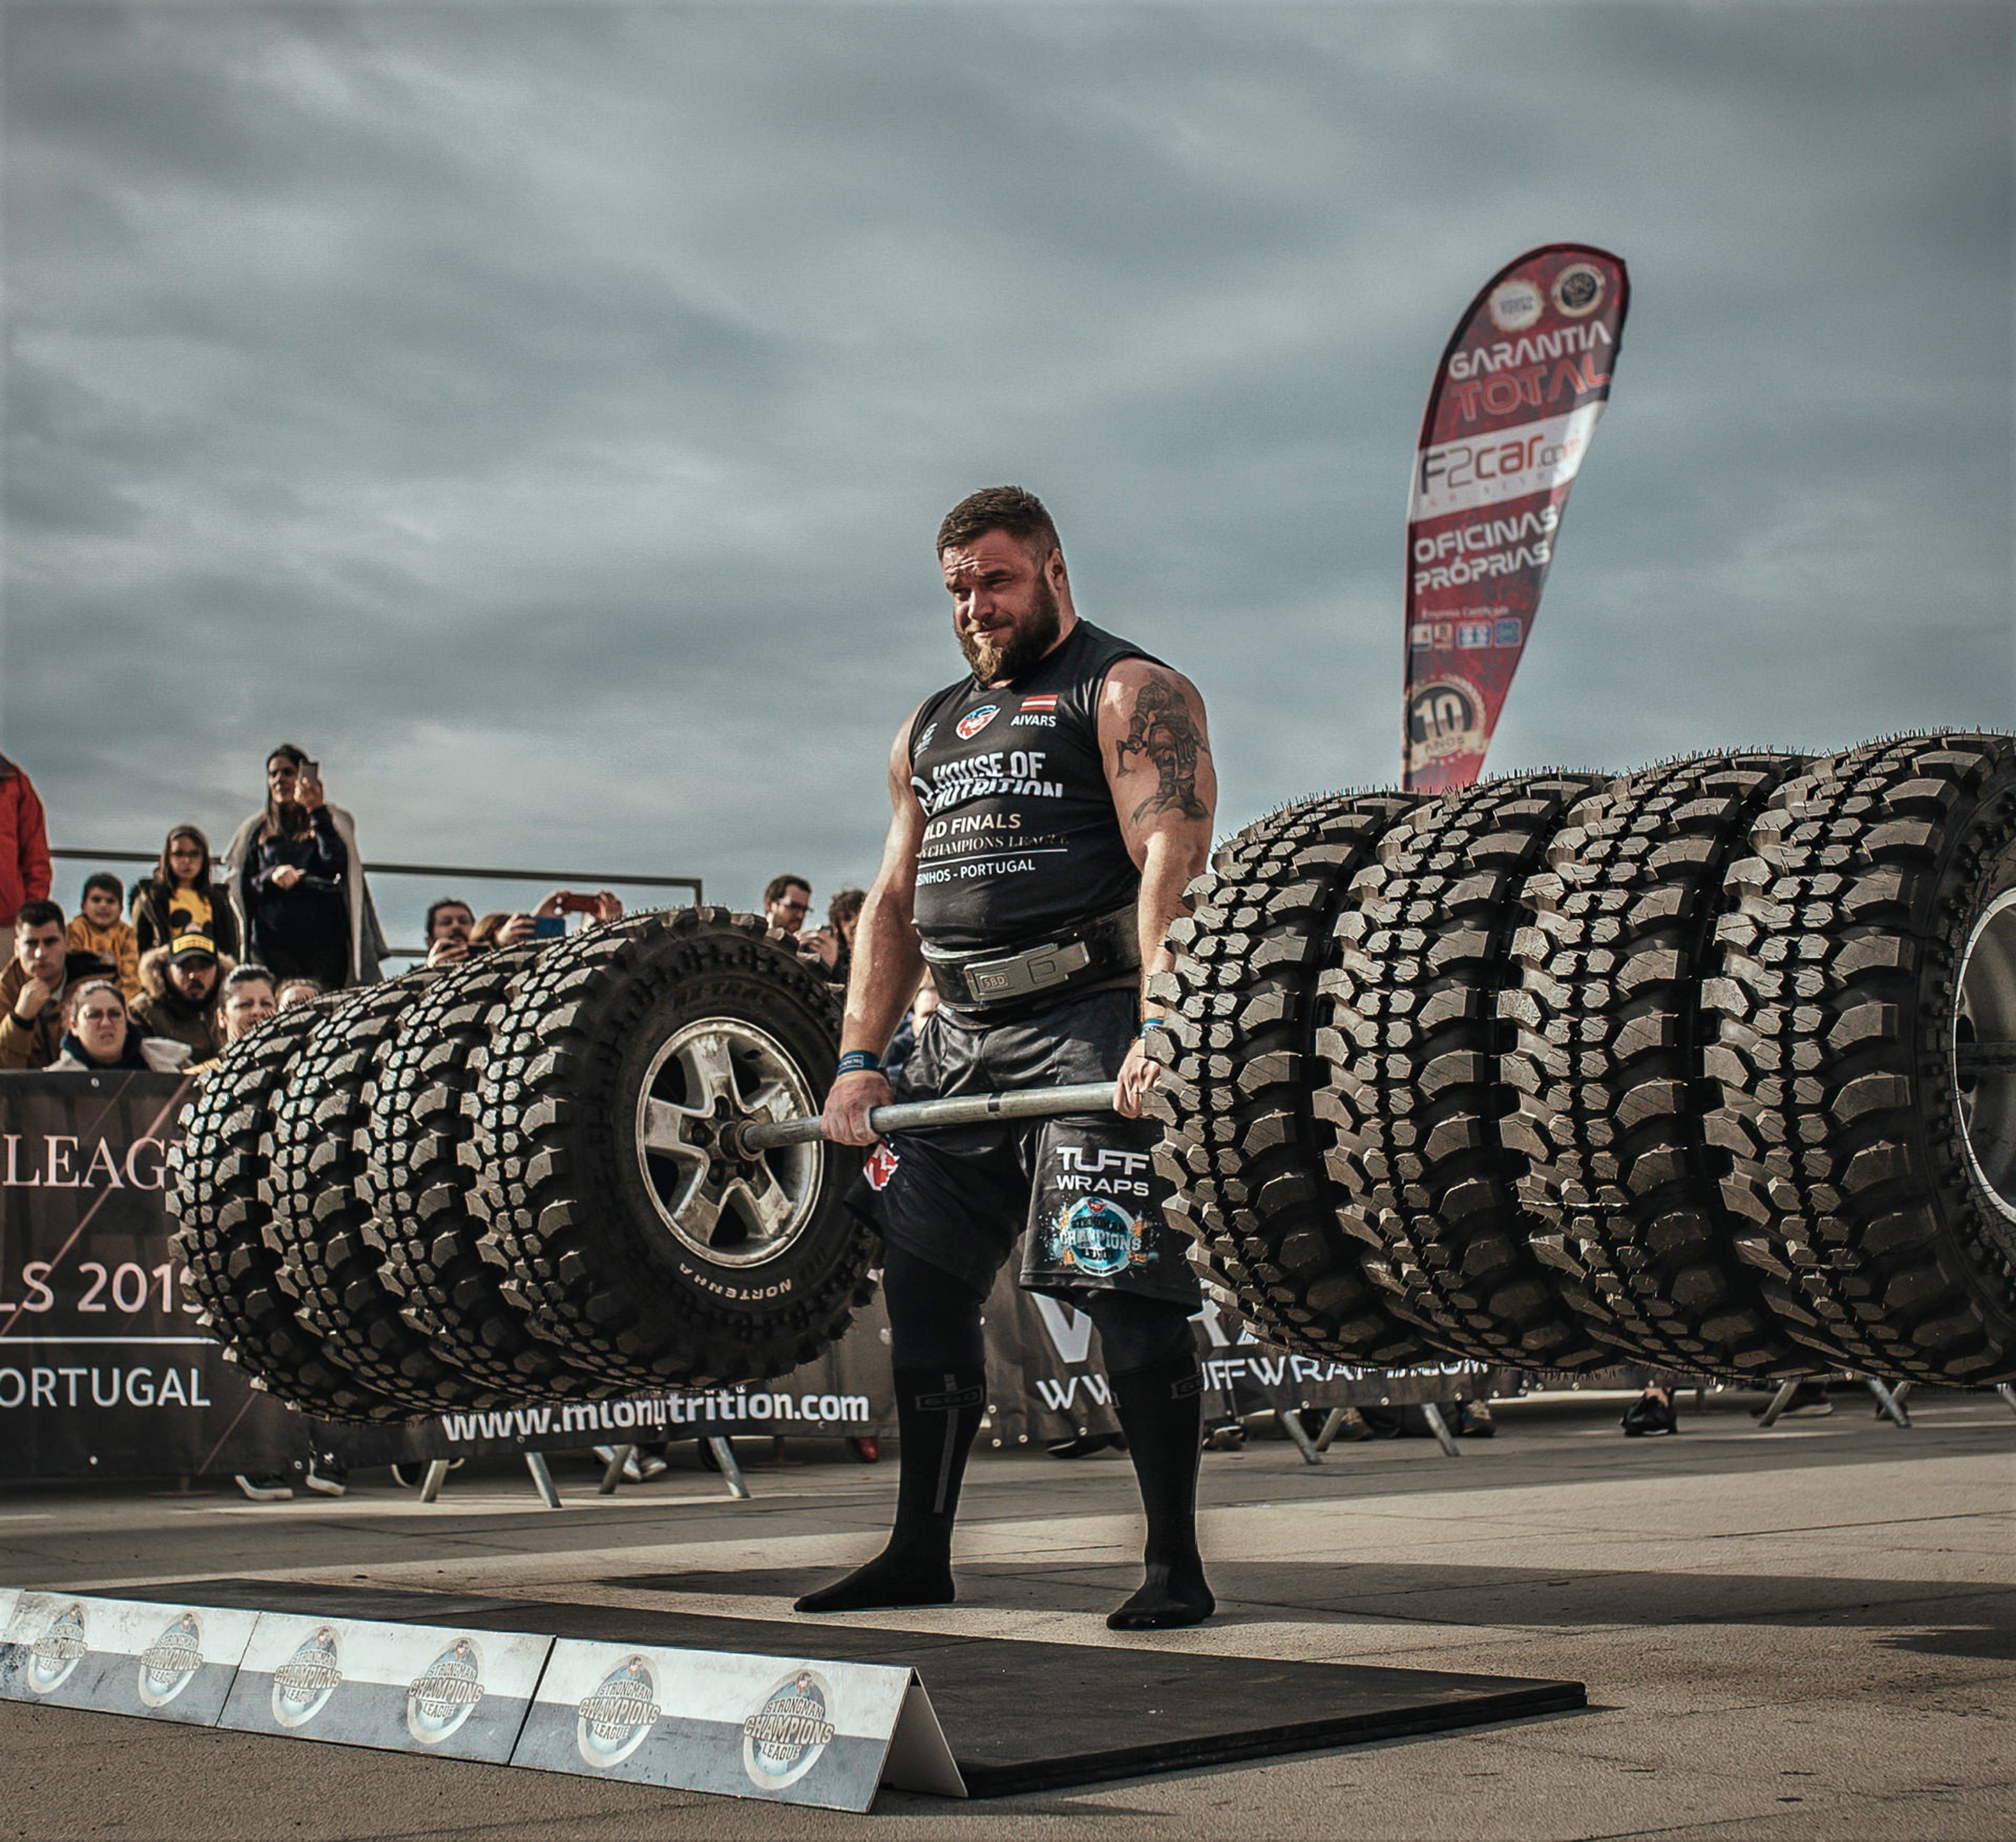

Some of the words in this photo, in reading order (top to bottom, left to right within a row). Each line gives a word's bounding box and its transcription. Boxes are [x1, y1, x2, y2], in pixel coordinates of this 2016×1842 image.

[1449, 321, 1612, 379] GARANTIA
[1453, 354, 1611, 421] TOTAL
[1414, 504, 1559, 564] OFICINAS
[1414, 540, 1550, 595] PRÓPRIAS
[1011, 715, 1056, 727] AIVARS
[1414, 694, 1464, 739] 10
[932, 752, 1003, 789] HOUSE
[1010, 751, 1046, 779] OF
[951, 813, 1021, 835] FINALS
[961, 859, 1036, 878] PORTUGAL
[2, 1134, 185, 1190] LEAG
[1056, 1147, 1149, 1175] TUFF
[1056, 1175, 1149, 1196] WRAPS
[679, 1263, 792, 1300] NORTENHA
[141, 1647, 203, 1671] CHAMPIONS
[428, 1662, 477, 1680] STRONGMAN
[274, 1665, 343, 1689] CHAMPIONS
[408, 1678, 485, 1704] CHAMPIONS
[600, 1681, 652, 1699] STRONGMAN
[423, 1703, 456, 1718] LEAGUE
[579, 1697, 661, 1725] CHAMPIONS
[766, 1698, 823, 1718] STRONGMAN
[595, 1724, 629, 1739] LEAGUE
[743, 1714, 835, 1745] CHAMPIONS
[763, 1744, 801, 1760] LEAGUE
